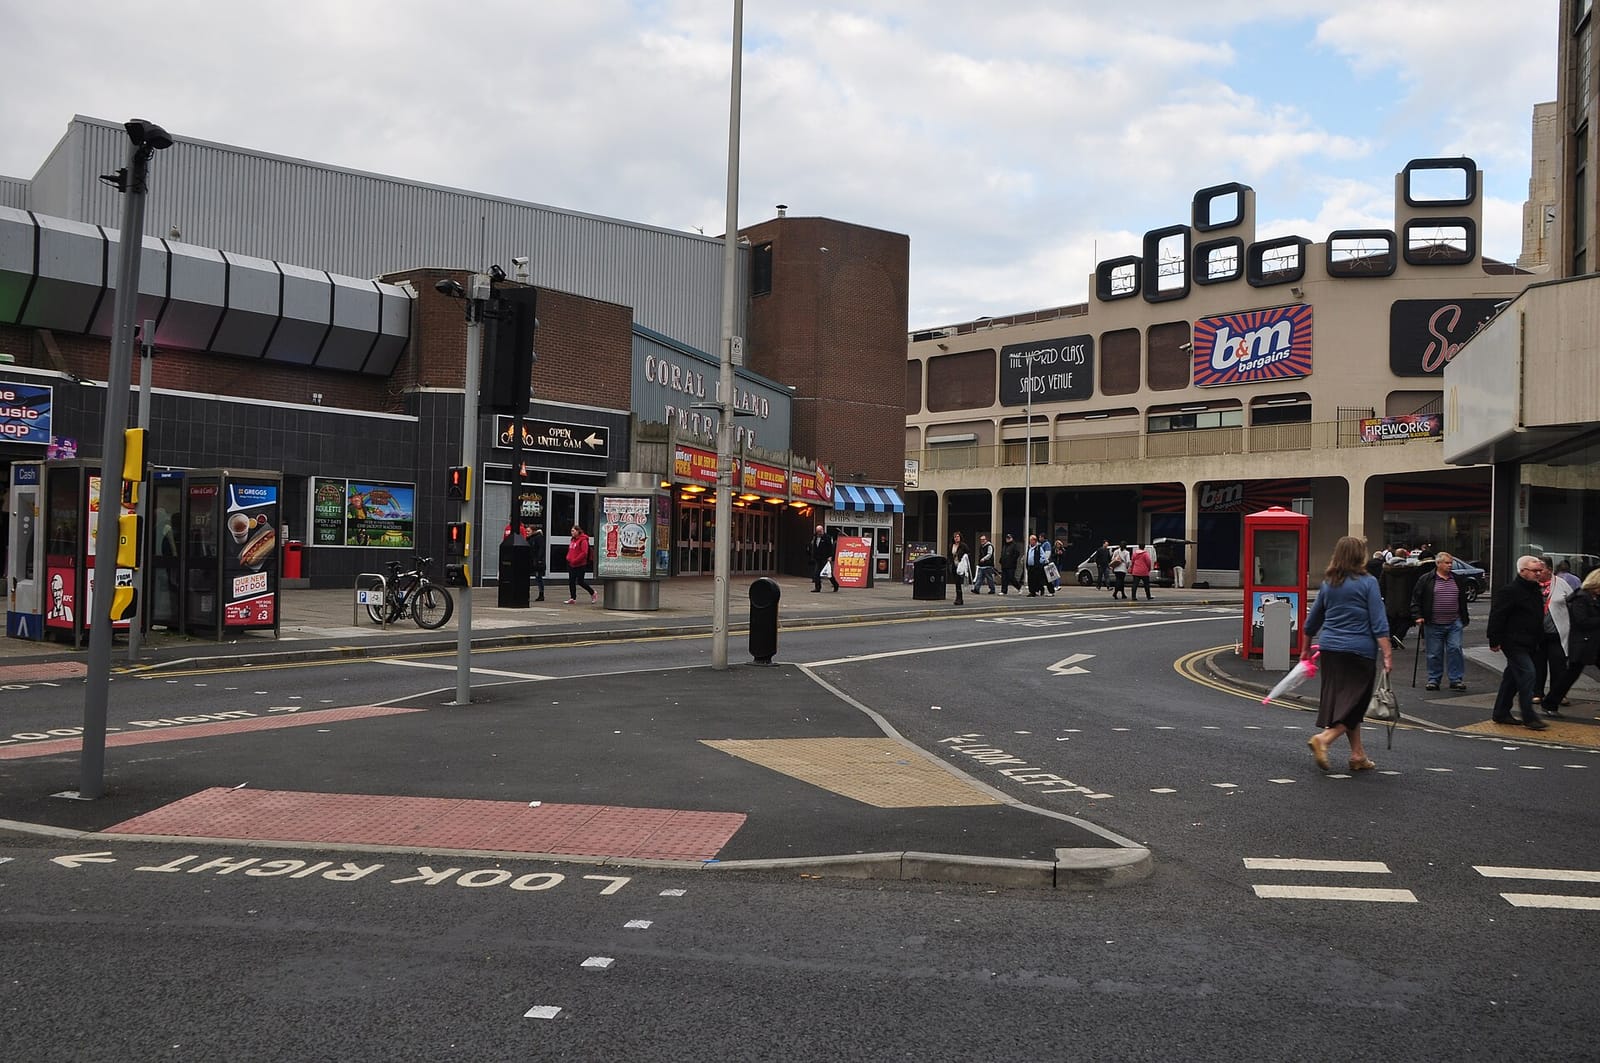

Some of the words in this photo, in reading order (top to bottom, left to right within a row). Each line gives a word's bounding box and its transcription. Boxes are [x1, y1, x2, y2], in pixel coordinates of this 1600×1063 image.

[1212, 320, 1291, 370] b&m
[1009, 352, 1022, 368] THE
[1025, 348, 1058, 366] WORLD
[1061, 344, 1085, 365] CLASS
[1238, 349, 1290, 373] bargains
[645, 354, 706, 399] CORAL
[1020, 375, 1046, 394] SANDS
[1048, 372, 1073, 390] VENUE
[716, 380, 770, 419] ILAND
[549, 427, 572, 440] OPEN
[665, 404, 755, 450] ENTRCE
[1365, 421, 1431, 437] FIREWORKS
[501, 431, 534, 447] CANO
[537, 436, 561, 448] UNTIL
[563, 440, 582, 449] 6AM
[19, 468, 36, 480] Cash
[243, 488, 268, 496] GREGGS
[315, 505, 342, 513] ROULETTE
[837, 557, 866, 567] FREE
[117, 573, 131, 581] FROM
[235, 577, 249, 586] OUR
[250, 575, 265, 583] NEW
[235, 584, 249, 593] HOT
[250, 581, 266, 590] DOG
[257, 610, 268, 620] £3
[128, 709, 258, 728] RIGHT
[950, 744, 1028, 766] LOOK
[997, 767, 1095, 794] LEFT
[134, 855, 384, 881] RIGHT
[390, 866, 632, 895] LOOK
